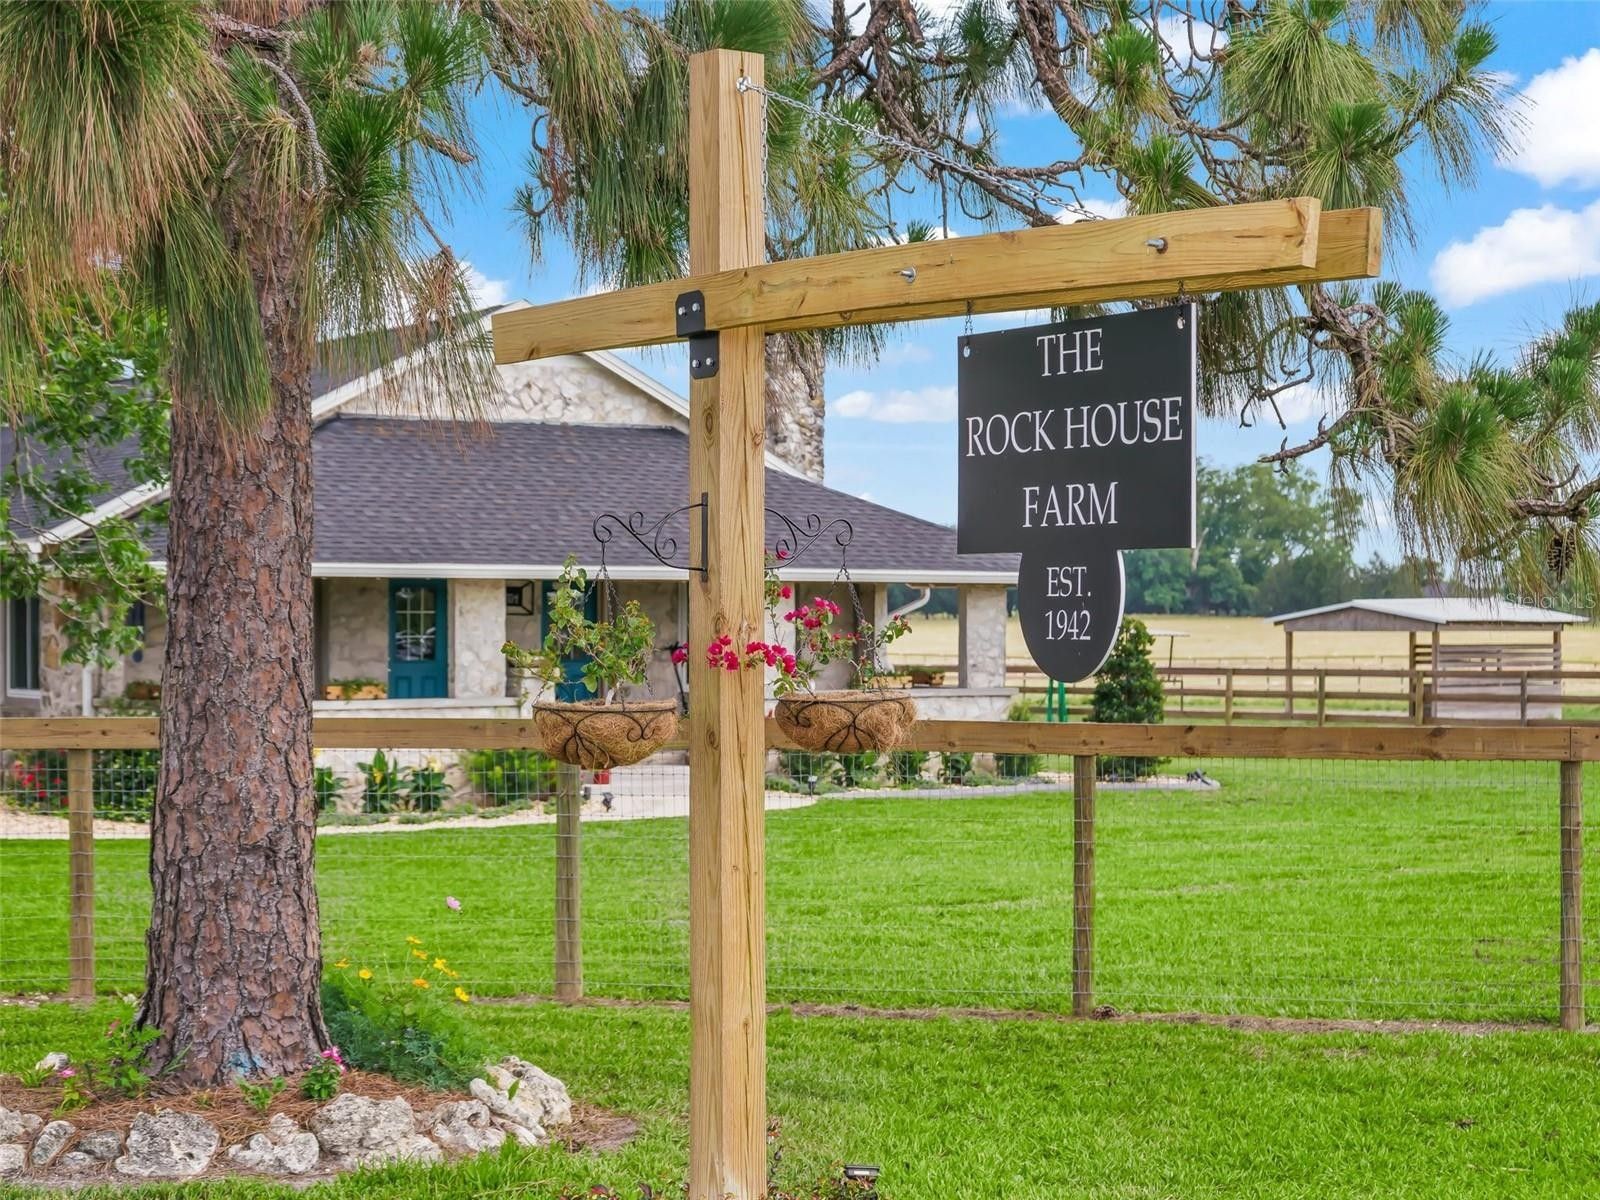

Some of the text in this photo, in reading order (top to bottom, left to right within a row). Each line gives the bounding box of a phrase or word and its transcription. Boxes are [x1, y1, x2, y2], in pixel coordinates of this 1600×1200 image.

[1036, 328, 1103, 377] THE
[966, 396, 1182, 457] ROCK HOUSE
[1022, 482, 1118, 528] FARM
[1046, 566, 1092, 597] EST.
[1045, 609, 1091, 640] 1942
